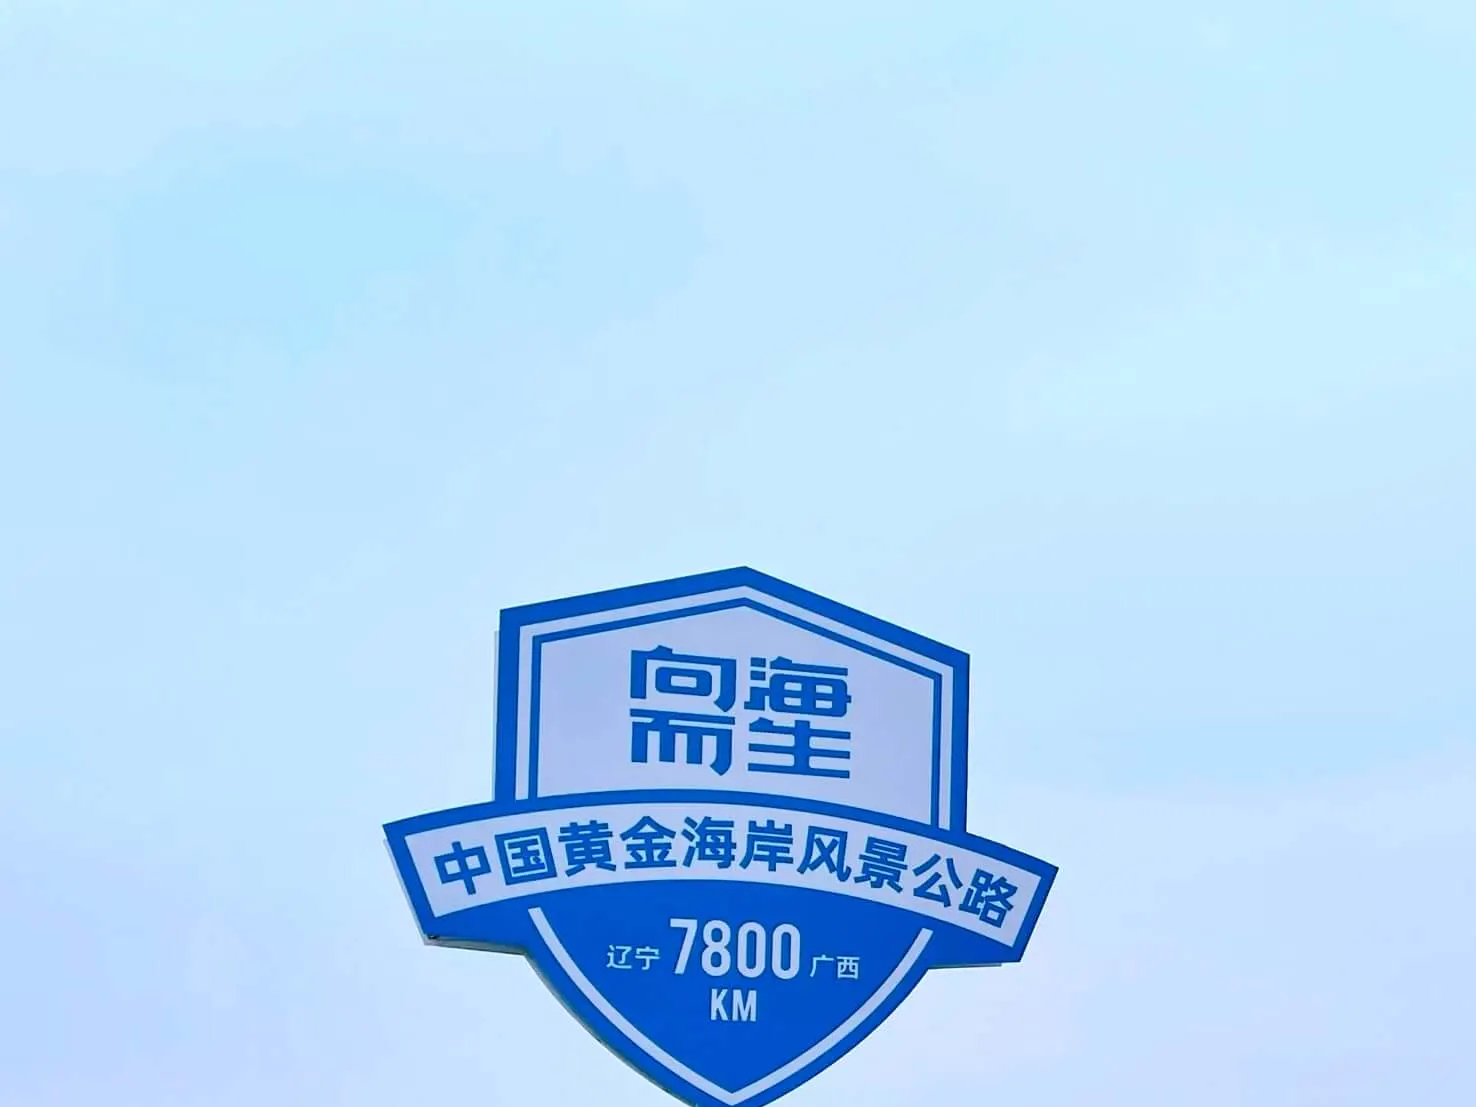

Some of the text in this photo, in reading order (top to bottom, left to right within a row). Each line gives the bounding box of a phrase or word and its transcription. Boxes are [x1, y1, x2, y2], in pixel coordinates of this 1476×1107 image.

[630, 645, 851, 717] 向海
[630, 708, 851, 778] 而生
[433, 815, 1018, 929] 中国黄金海岸风景公路
[606, 918, 860, 980] 辽宁 7800 广西
[710, 988, 757, 1022] KM
